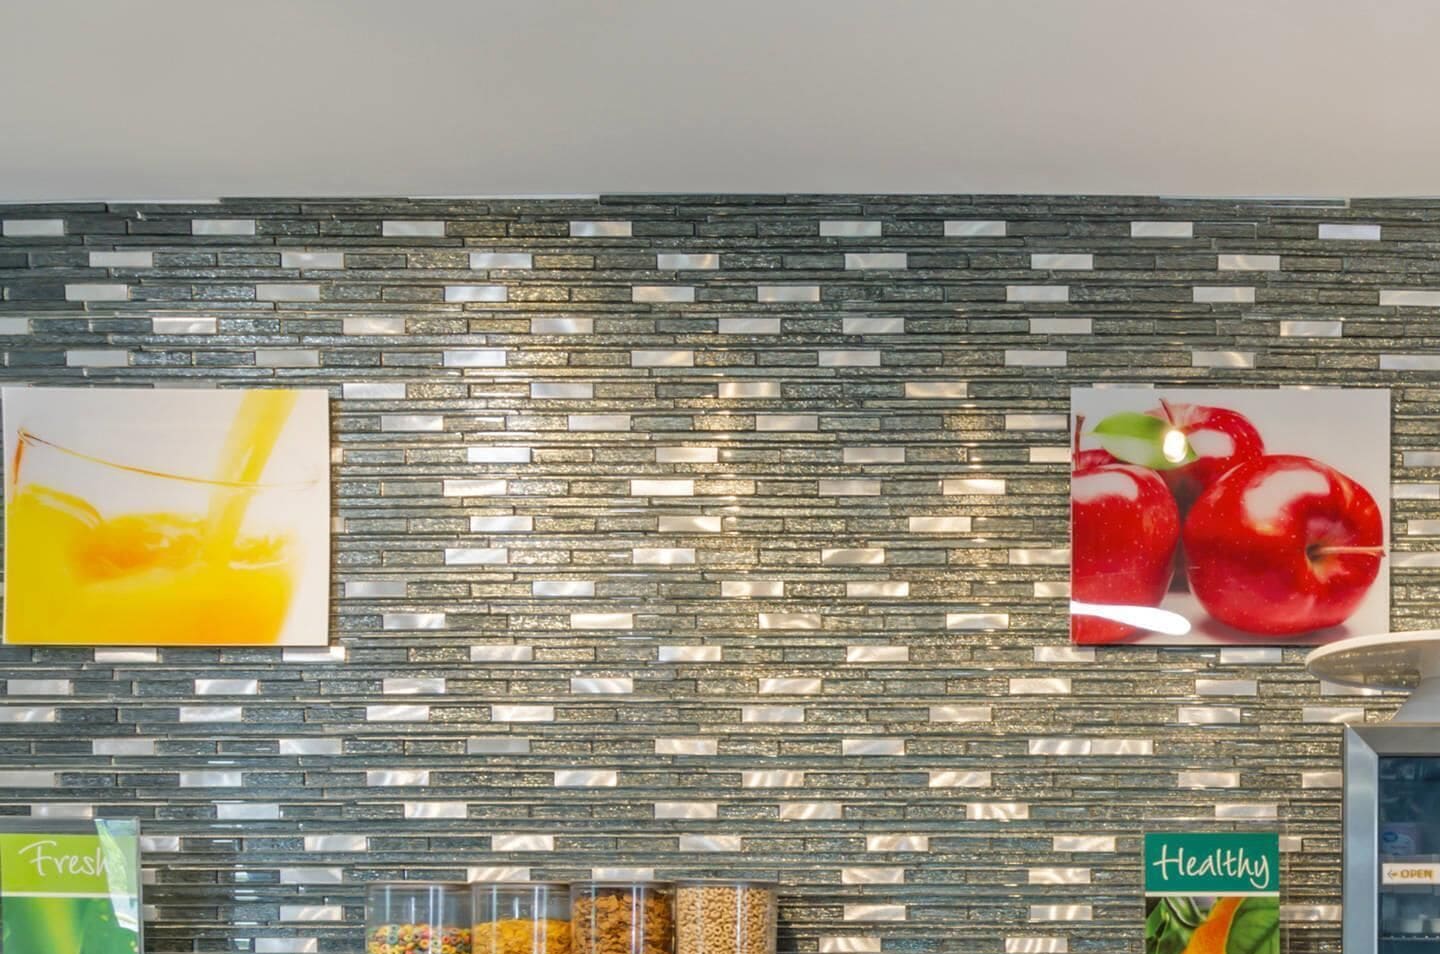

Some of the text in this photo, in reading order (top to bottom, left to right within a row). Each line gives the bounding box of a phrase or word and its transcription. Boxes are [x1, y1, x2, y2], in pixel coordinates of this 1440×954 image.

[18, 840, 110, 877] Fresh
[1152, 844, 1270, 889] Healthy
[1400, 869, 1433, 879] OPEN
